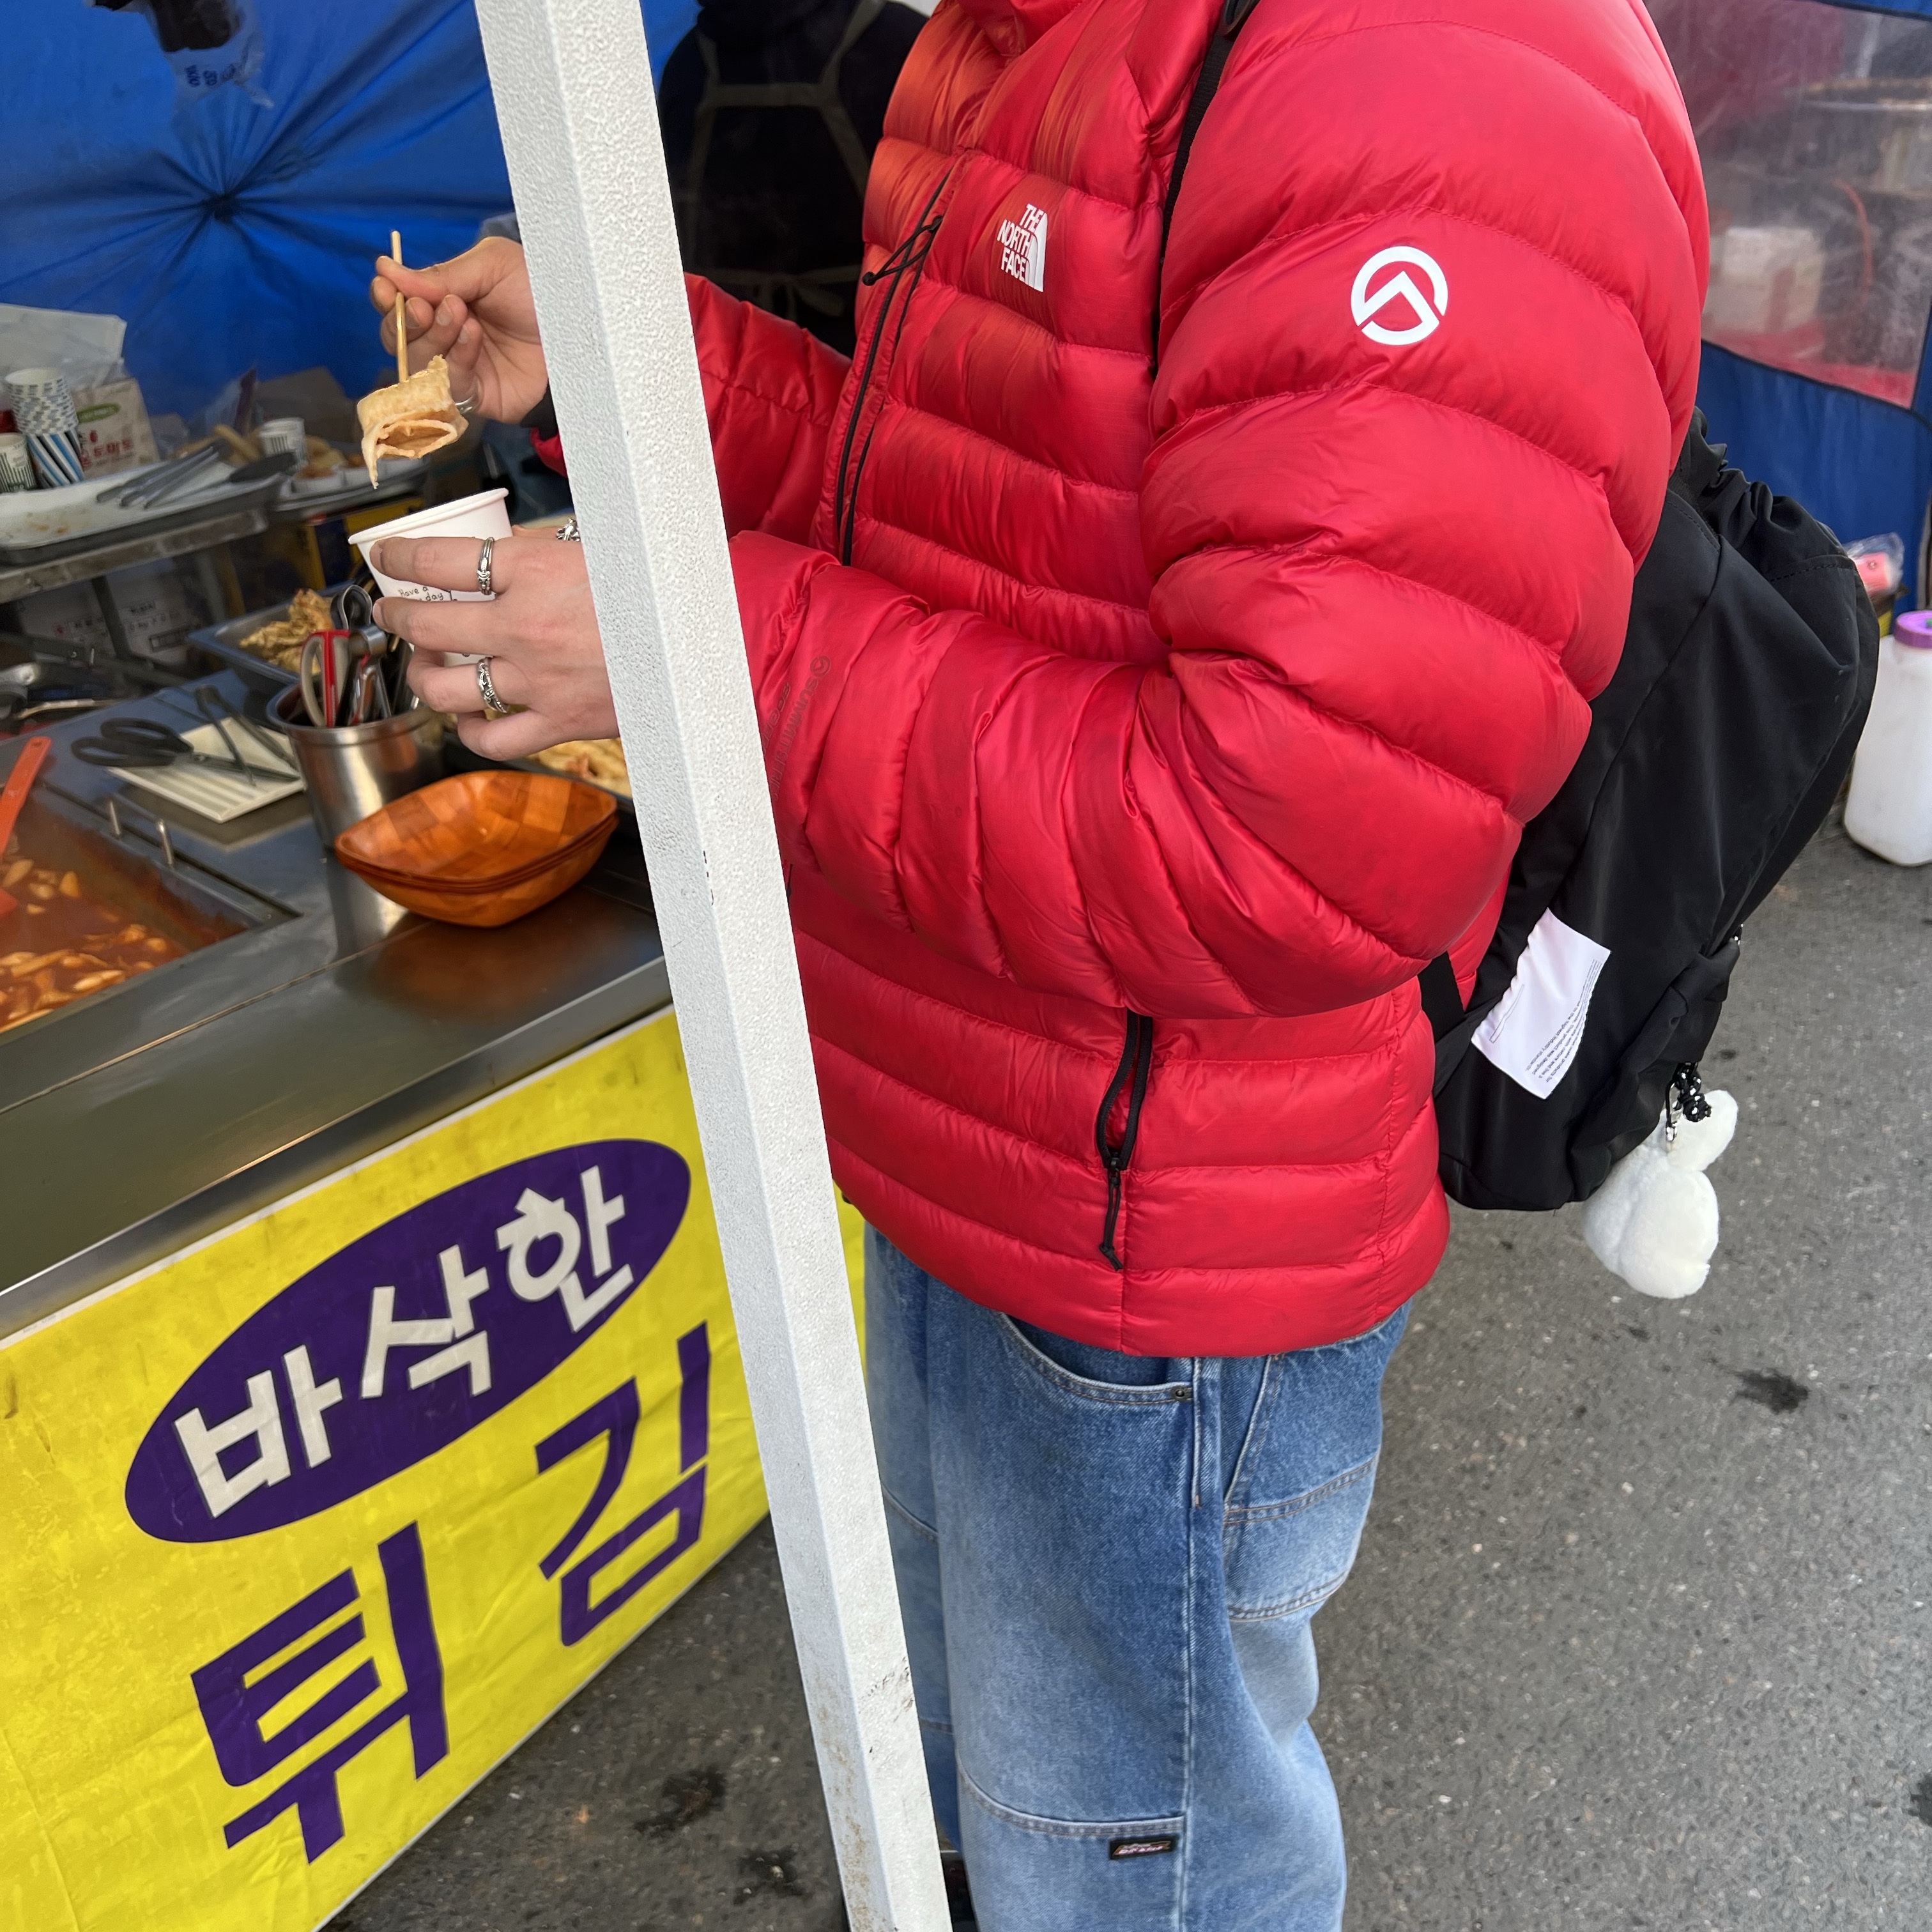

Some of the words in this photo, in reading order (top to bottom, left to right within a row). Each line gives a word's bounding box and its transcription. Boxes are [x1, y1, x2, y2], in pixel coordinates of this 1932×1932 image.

[1020, 203, 1045, 233] THE
[997, 219, 1034, 257] NORTH
[1000, 247, 1027, 283] FACE
[398, 588, 420, 597] Have
[425, 592, 444, 602] day
[173, 1165, 635, 1519] 바삭한
[190, 1320, 710, 1864] 튀김
